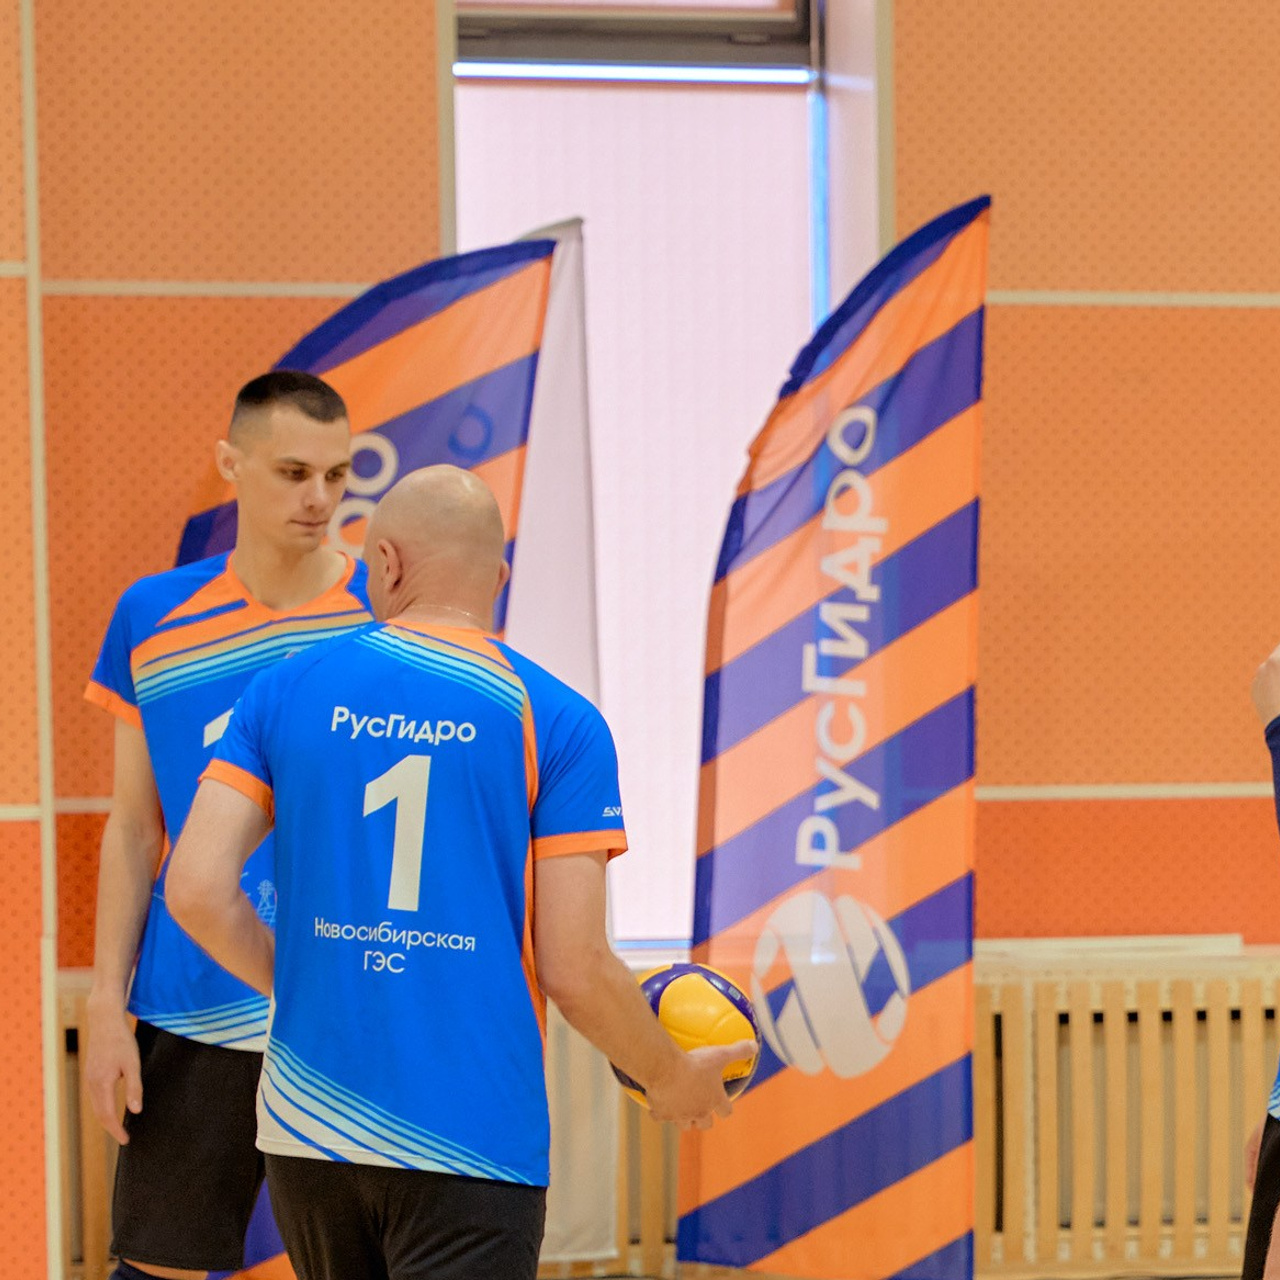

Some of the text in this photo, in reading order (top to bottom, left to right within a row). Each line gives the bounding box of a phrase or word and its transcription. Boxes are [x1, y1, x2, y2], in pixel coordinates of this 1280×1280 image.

[795, 405, 888, 870] РусГидро
[331, 706, 477, 745] РусГидро
[363, 754, 431, 912] 1
[314, 917, 476, 951] Новосибирская
[363, 951, 406, 974] ГЭС
